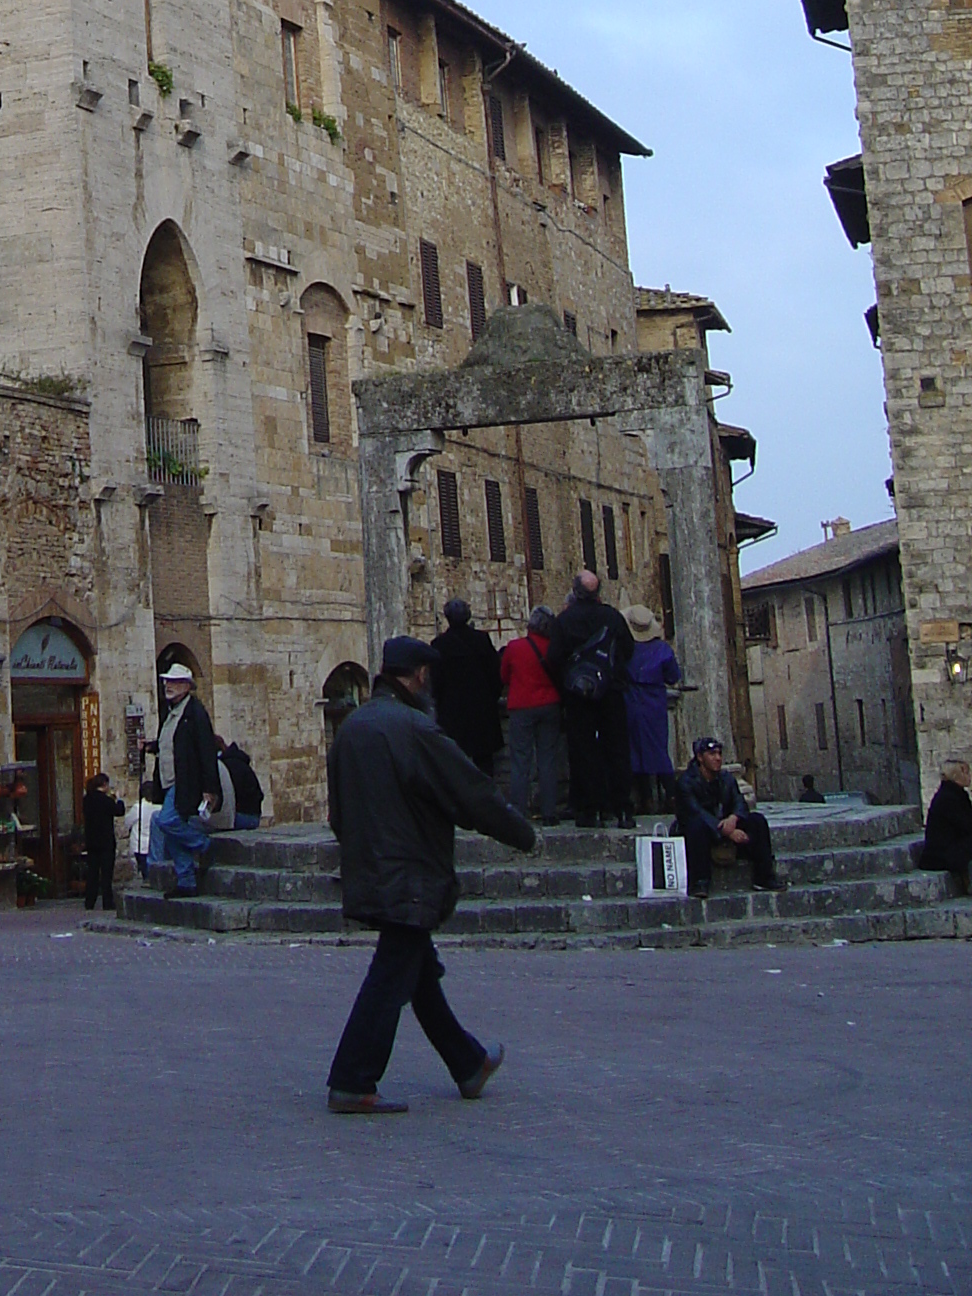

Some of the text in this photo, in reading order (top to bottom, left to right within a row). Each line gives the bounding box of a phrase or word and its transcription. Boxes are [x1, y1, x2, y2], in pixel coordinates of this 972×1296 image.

[90, 703, 99, 776] NATURAL
[665, 844, 675, 888] NO NAME
